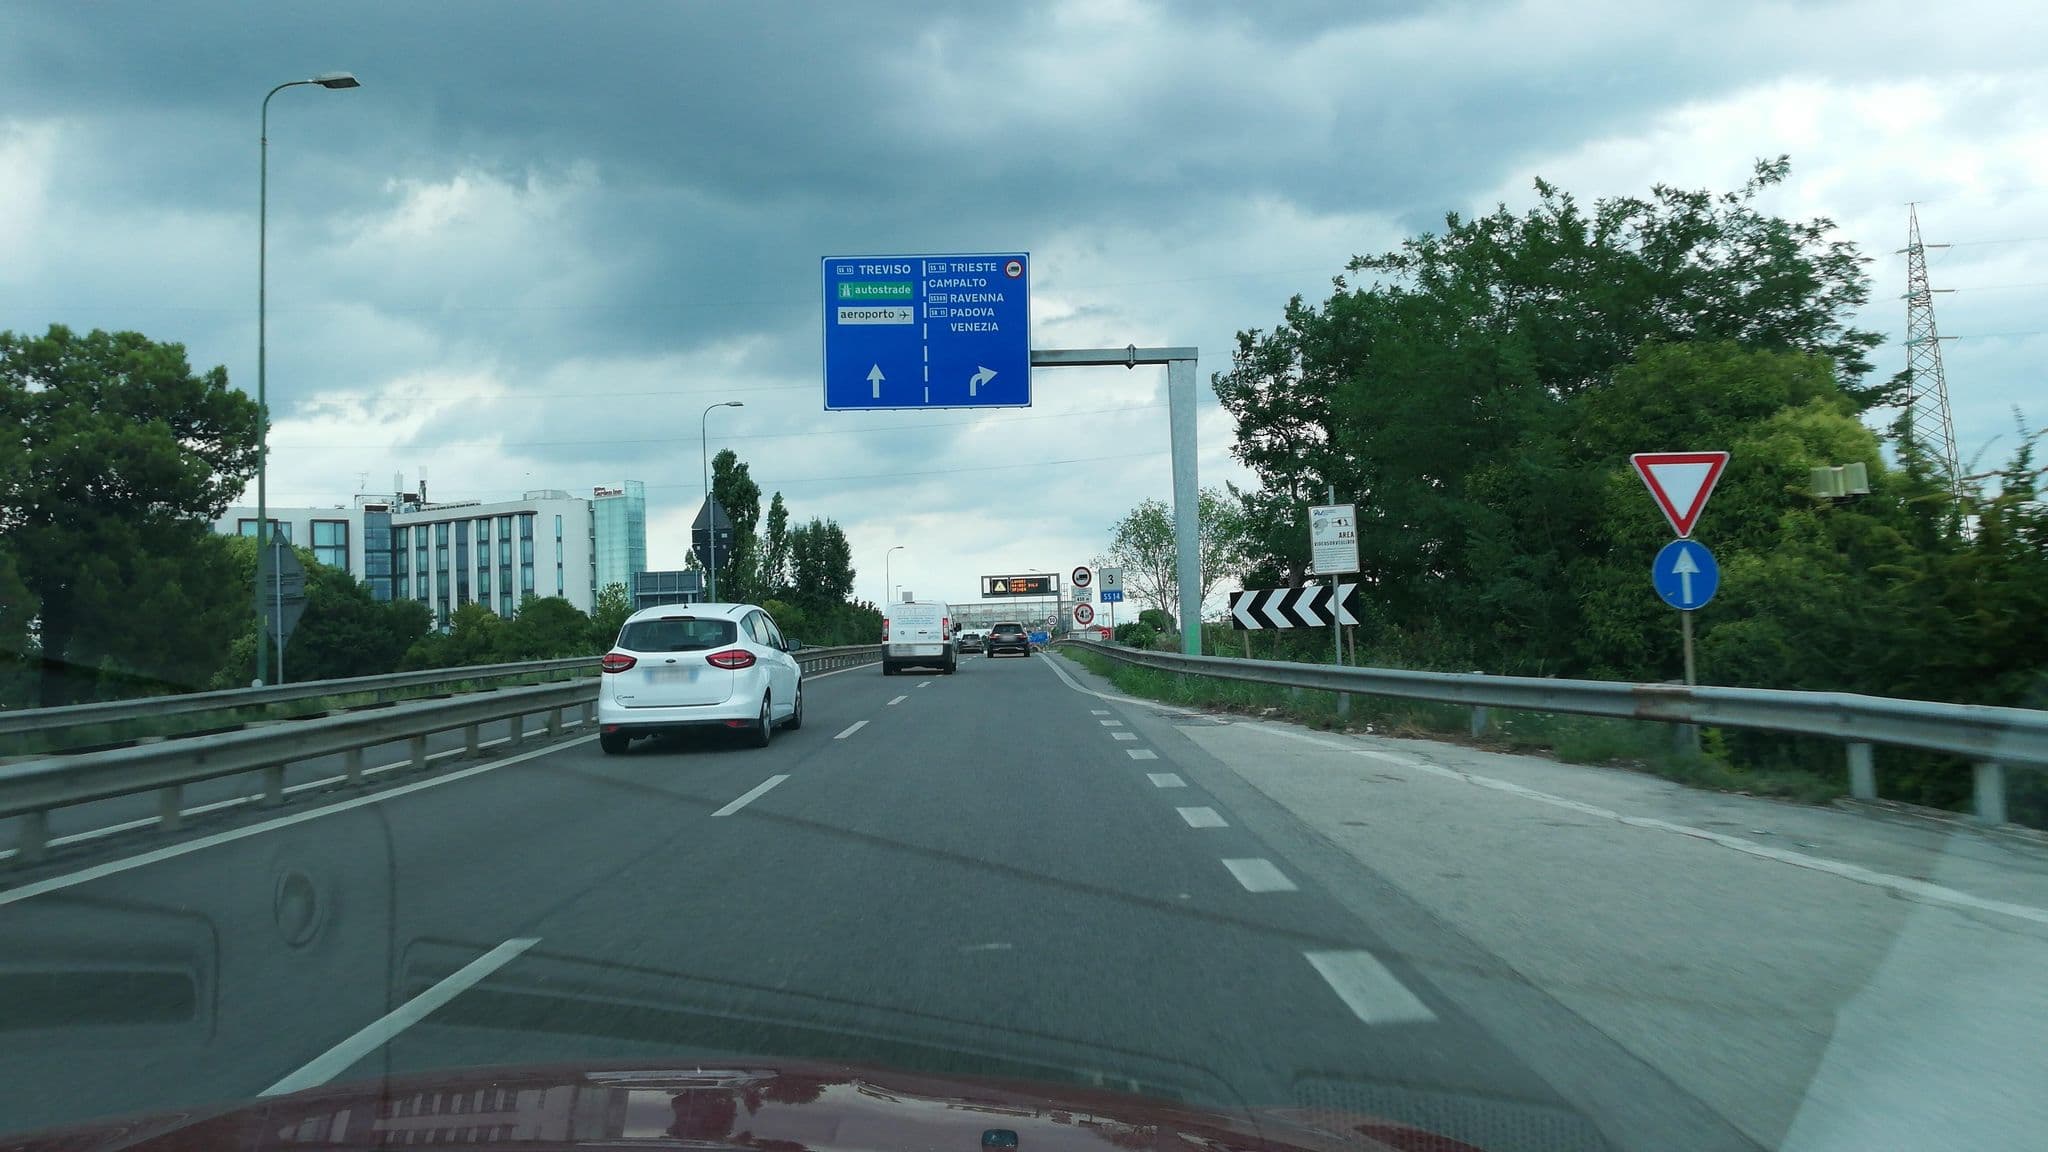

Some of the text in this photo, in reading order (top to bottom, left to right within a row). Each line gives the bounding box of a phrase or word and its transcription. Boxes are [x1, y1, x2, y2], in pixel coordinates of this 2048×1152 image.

[859, 264, 911, 274] TREVISO
[950, 262, 997, 272] TRIESTE
[928, 278, 987, 288] CAMPALTO
[855, 285, 911, 295] autostrade
[950, 293, 1004, 303] RAVENNA
[840, 309, 895, 320] aeroporto
[950, 308, 995, 317] PADOVA
[950, 322, 999, 332] VENEZIA
[1339, 531, 1355, 539] AREA
[1108, 574, 1114, 585] 3
[1103, 592, 1120, 601] SS 14
